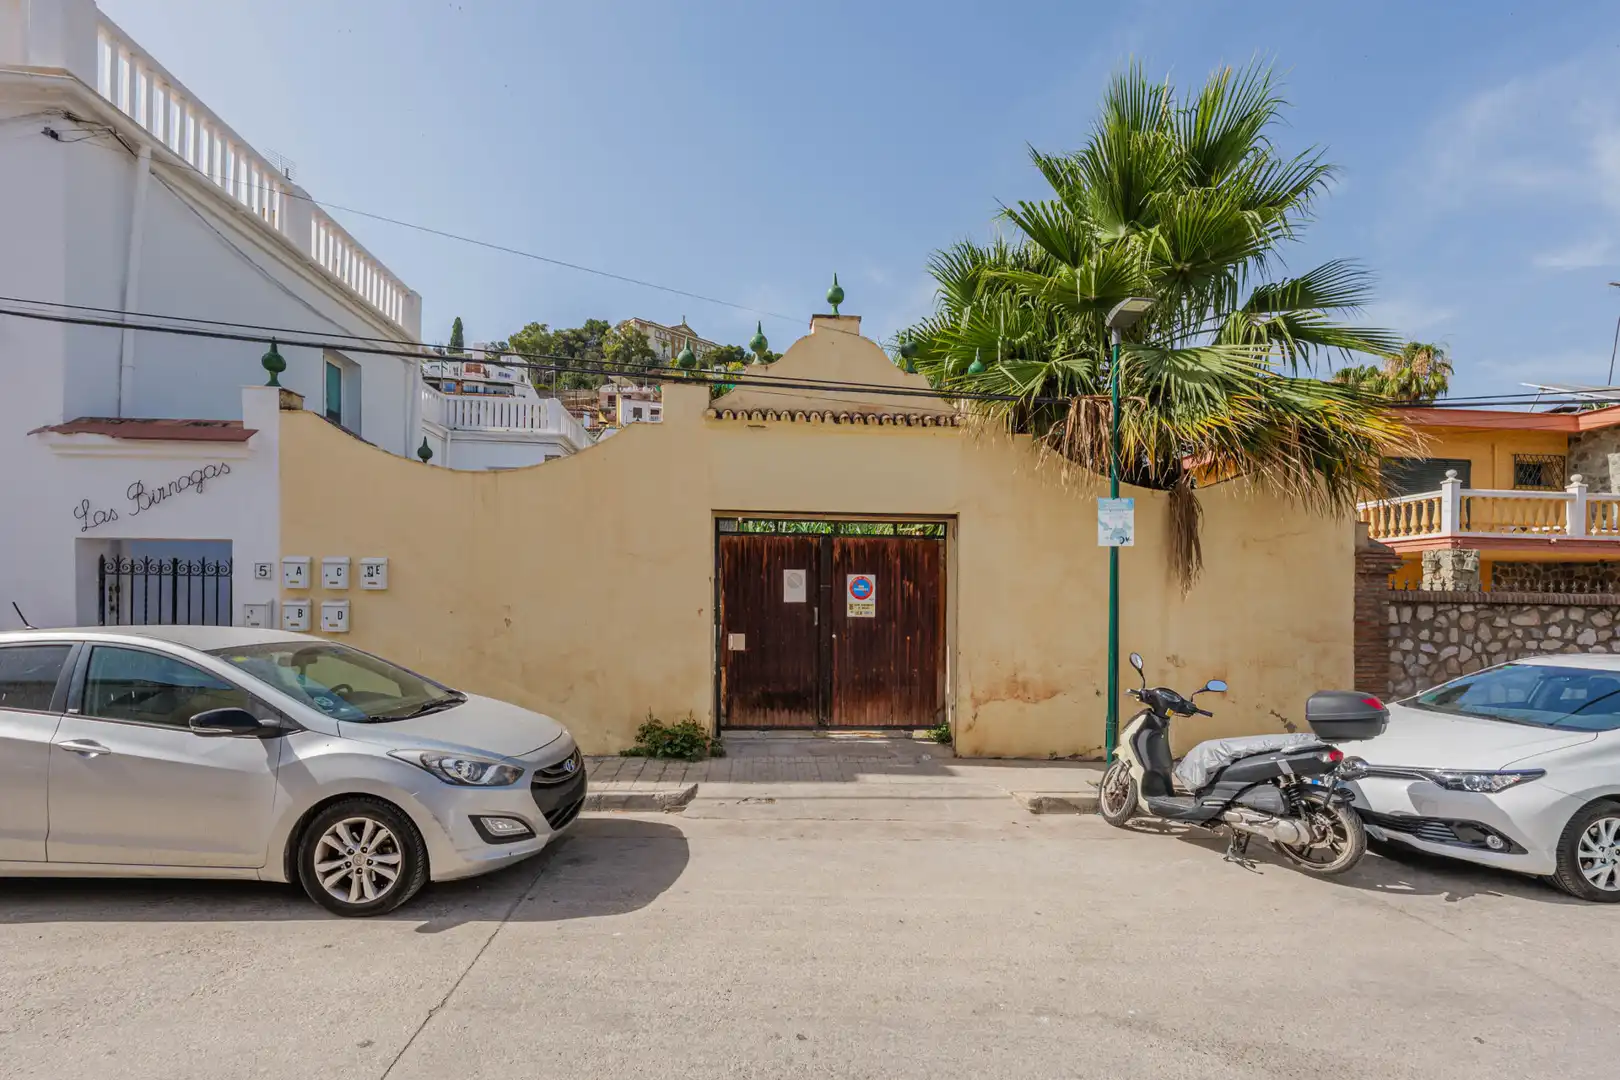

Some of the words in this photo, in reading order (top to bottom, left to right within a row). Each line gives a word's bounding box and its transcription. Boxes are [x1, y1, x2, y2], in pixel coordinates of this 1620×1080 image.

[73, 498, 119, 532] Las
[258, 565, 268, 577] 5
[295, 566, 302, 576] A
[336, 567, 342, 577] C
[375, 565, 381, 575] E
[297, 608, 303, 618] B
[337, 610, 343, 620] D
